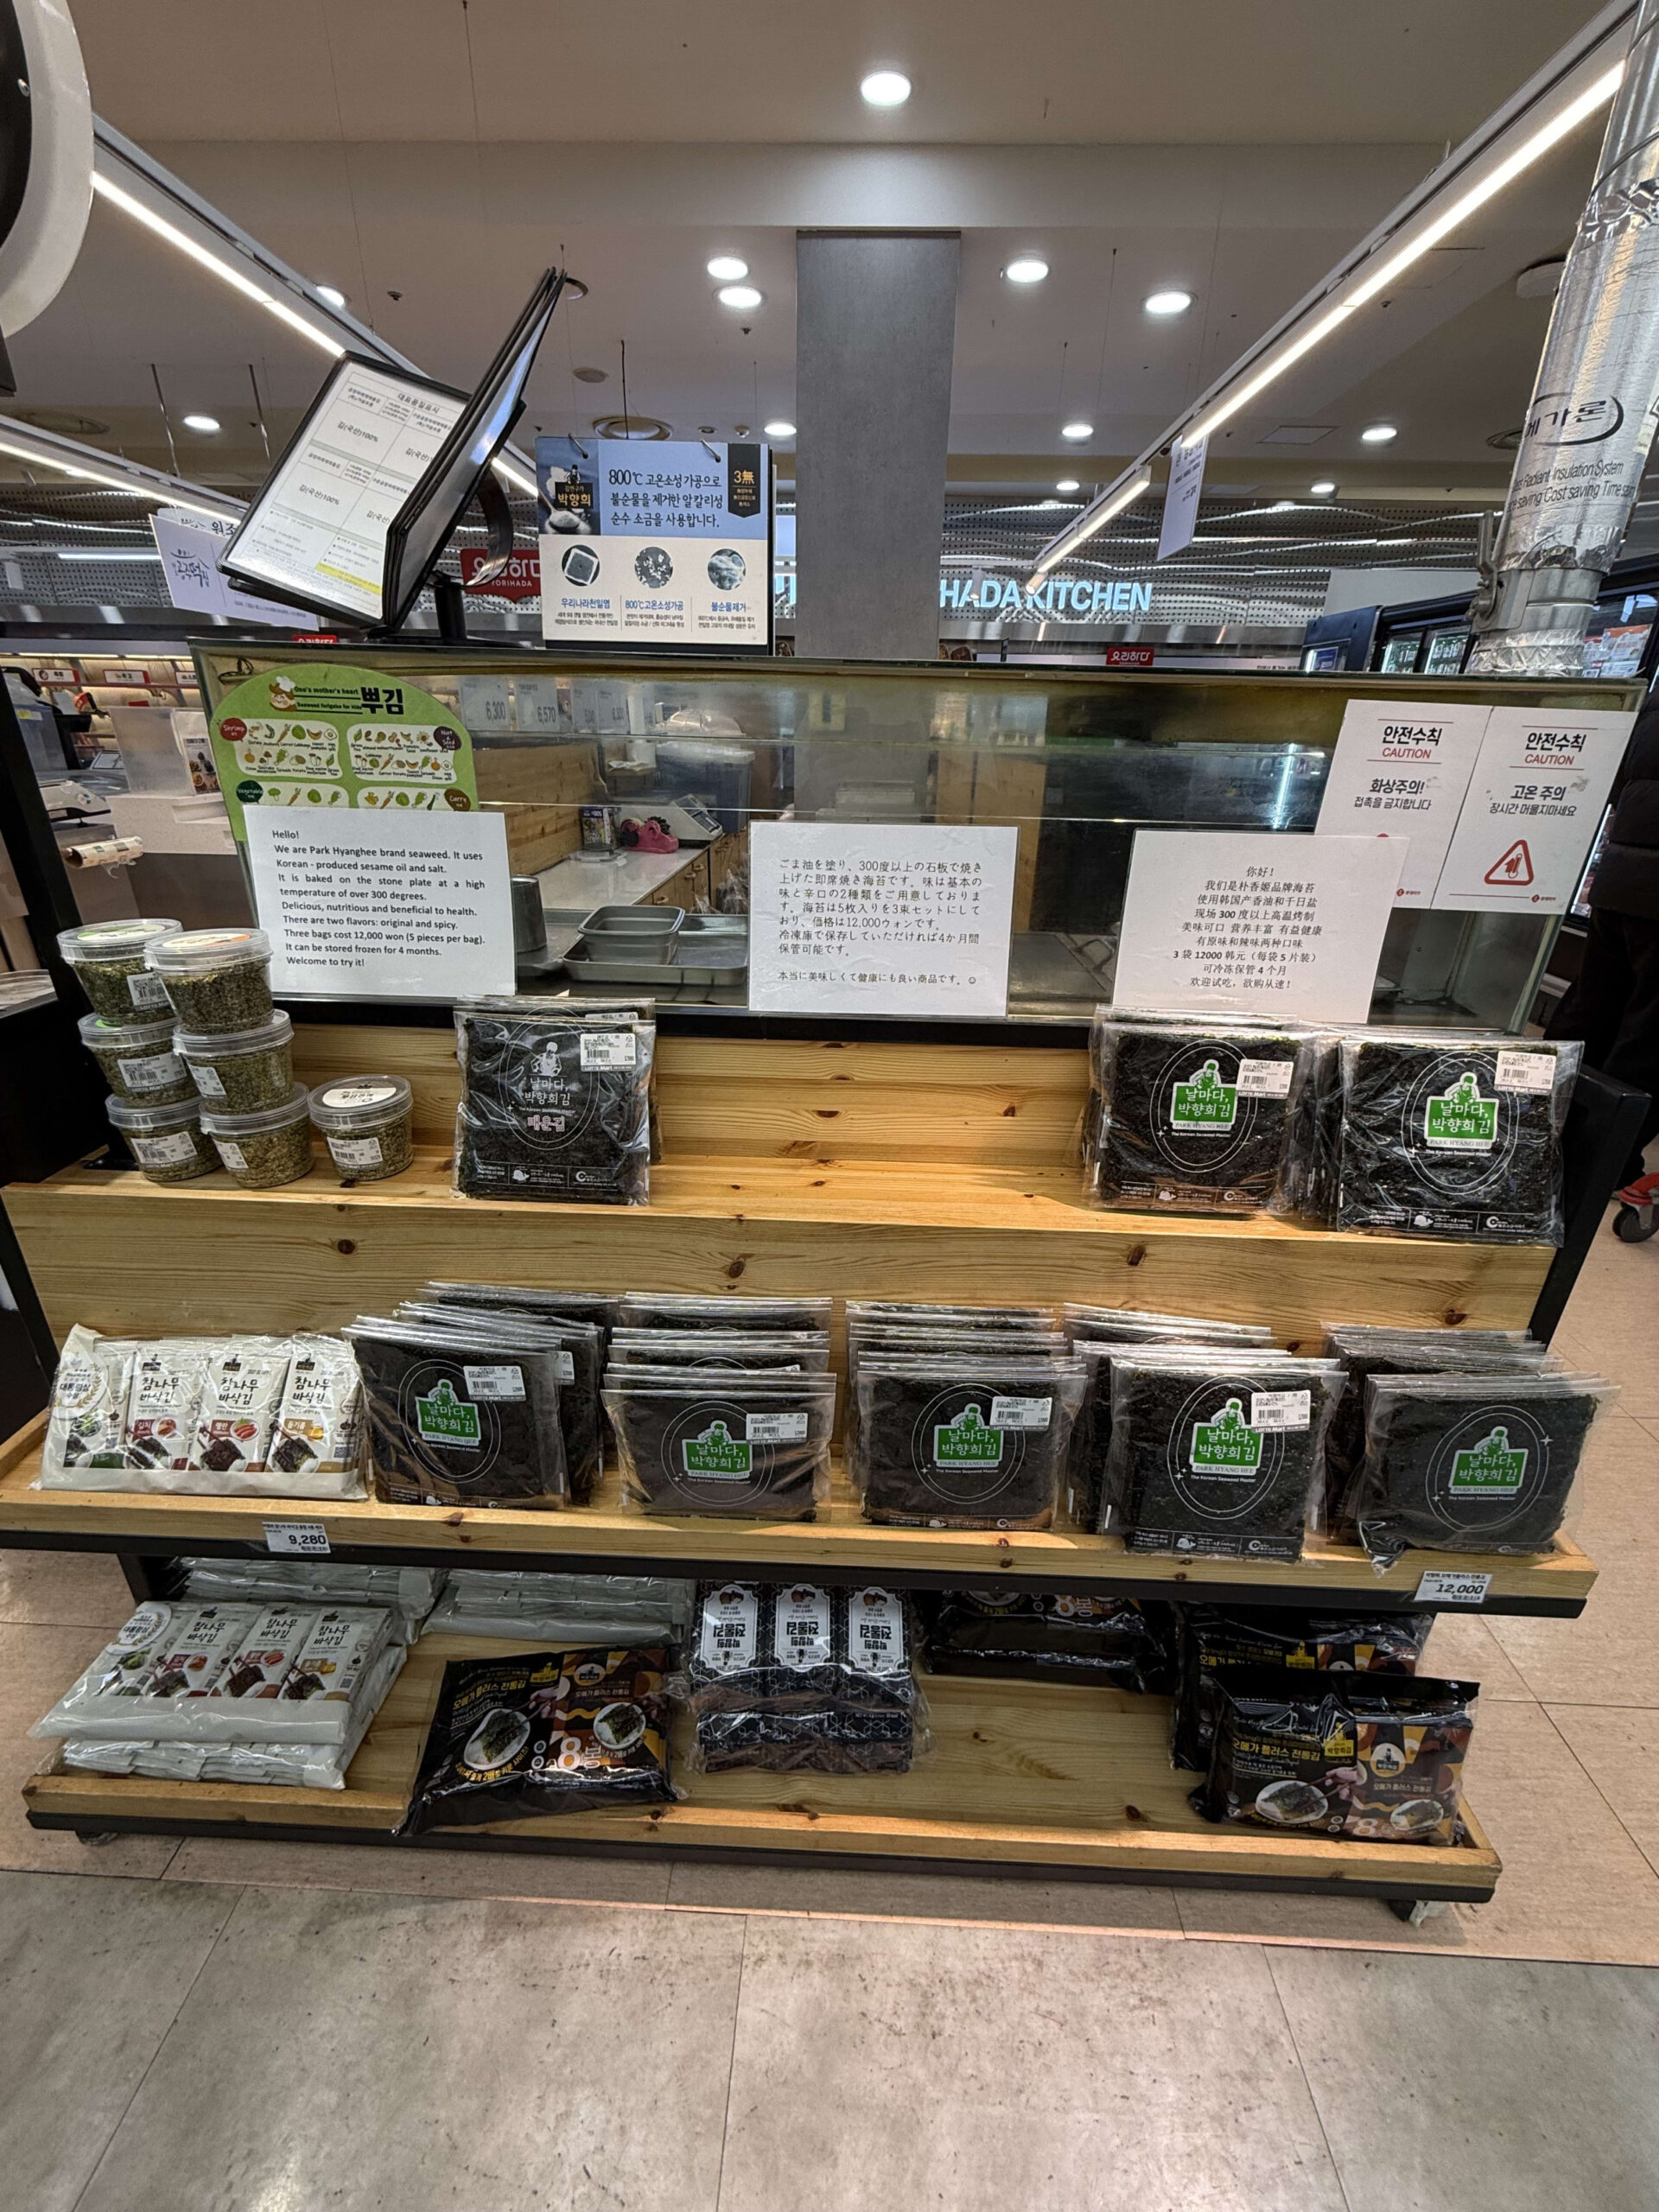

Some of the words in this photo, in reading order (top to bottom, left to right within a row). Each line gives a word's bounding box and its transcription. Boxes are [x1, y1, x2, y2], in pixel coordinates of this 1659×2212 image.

[1595, 460, 1624, 477] System
[734, 470, 754, 484] 3無
[557, 493, 592, 507] 박향희
[1544, 487, 1567, 502] Cost
[1568, 484, 1600, 499] saving
[611, 493, 650, 506] 불순물을
[652, 493, 680, 507] 제거한
[683, 494, 722, 509] 알칼리성
[611, 512, 631, 525] 순수
[633, 513, 664, 526] 소금을
[665, 514, 719, 527] 사용합니다.
[1026, 581, 1153, 611] KITCHEN
[1111, 651, 1150, 662] 요리하다
[1382, 725, 1442, 747] 안전수칙
[1525, 732, 1586, 753] 안전수칙
[1382, 747, 1432, 760] CAUTION
[1524, 753, 1574, 766] CAUTION
[1370, 778, 1425, 795] 화상주의!
[1510, 785, 1538, 800] 고온
[1539, 785, 1567, 802] 주의
[1354, 796, 1383, 809] 접촉을
[1384, 797, 1432, 810] 금지합니다
[1490, 803, 1519, 816] 장시간
[1520, 804, 1577, 817] 머물지마세요
[272, 830, 299, 839] Hello!
[275, 845, 289, 854] We
[309, 846, 330, 855] Park
[333, 847, 377, 857] Hyanghee
[380, 849, 405, 857] brand
[409, 849, 450, 859] seaweed.
[276, 859, 308, 868] Korean
[316, 861, 358, 871] produced
[396, 862, 407, 872] oil
[429, 864, 447, 873] salt.
[278, 873, 285, 881] It
[306, 874, 332, 883] baked
[357, 875, 372, 884] the
[410, 878, 432, 887] plate
[466, 880, 486, 890] high
[280, 888, 335, 899] temperature
[339, 889, 347, 898] of
[371, 890, 387, 899] 300
[390, 891, 426, 902] degrees.
[282, 902, 324, 912] Delicious,
[327, 903, 370, 912] nutritious
[372, 904, 388, 912] and
[391, 905, 432, 914] beneficial
[446, 906, 477, 916] health.
[346, 918, 378, 926] flavors:
[380, 918, 413, 929] original
[416, 919, 432, 928] and
[434, 920, 458, 931] spicy.
[1181, 921, 1224, 933] 美味可口
[1230, 923, 1274, 935] 营养丰富
[1279, 923, 1322, 937] 有益健康
[312, 930, 332, 940] bags
[354, 931, 383, 941] 12,000
[406, 932, 415, 943] (5
[417, 933, 444, 944] pieces
[447, 936, 461, 944] per
[463, 934, 486, 945] bag).
[1197, 935, 1303, 949] 有原味和辣味两种口味
[311, 944, 323, 952] be
[406, 946, 442, 956] months.
[779, 944, 849, 956] 保管可能です。
[287, 957, 327, 965] Welcome
[340, 959, 353, 968] try
[355, 958, 365, 967] it!
[531, 1077, 569, 1091] 날마다,
[524, 1091, 559, 1105] 박향희
[562, 1092, 570, 1106] 김
[1185, 1089, 1229, 1103] 날마다,
[1179, 1103, 1217, 1117] 박향희
[1221, 1104, 1230, 1117] 김
[1441, 1103, 1488, 1118] 날마다,
[1433, 1118, 1474, 1134] 박향희
[1479, 1120, 1490, 1135] 김
[424, 1415, 461, 1431] 박향희
[463, 1421, 474, 1433] 김
[949, 1429, 994, 1442] 날마다,
[1207, 1429, 1253, 1445] 날마다,
[696, 1444, 742, 1457] 날마다,
[942, 1443, 982, 1456] 박향희
[984, 1444, 996, 1456] 김
[1198, 1445, 1240, 1460] 박향희
[1244, 1446, 1255, 1461] 김
[691, 1456, 731, 1468] 박향희
[734, 1457, 746, 1468] 김
[1469, 1454, 1516, 1468] 날마다,
[1459, 1468, 1502, 1481] 박향희
[1506, 1468, 1517, 1482] 김
[289, 1535, 326, 1546] 9,280
[1436, 1584, 1484, 1594] 12,000
